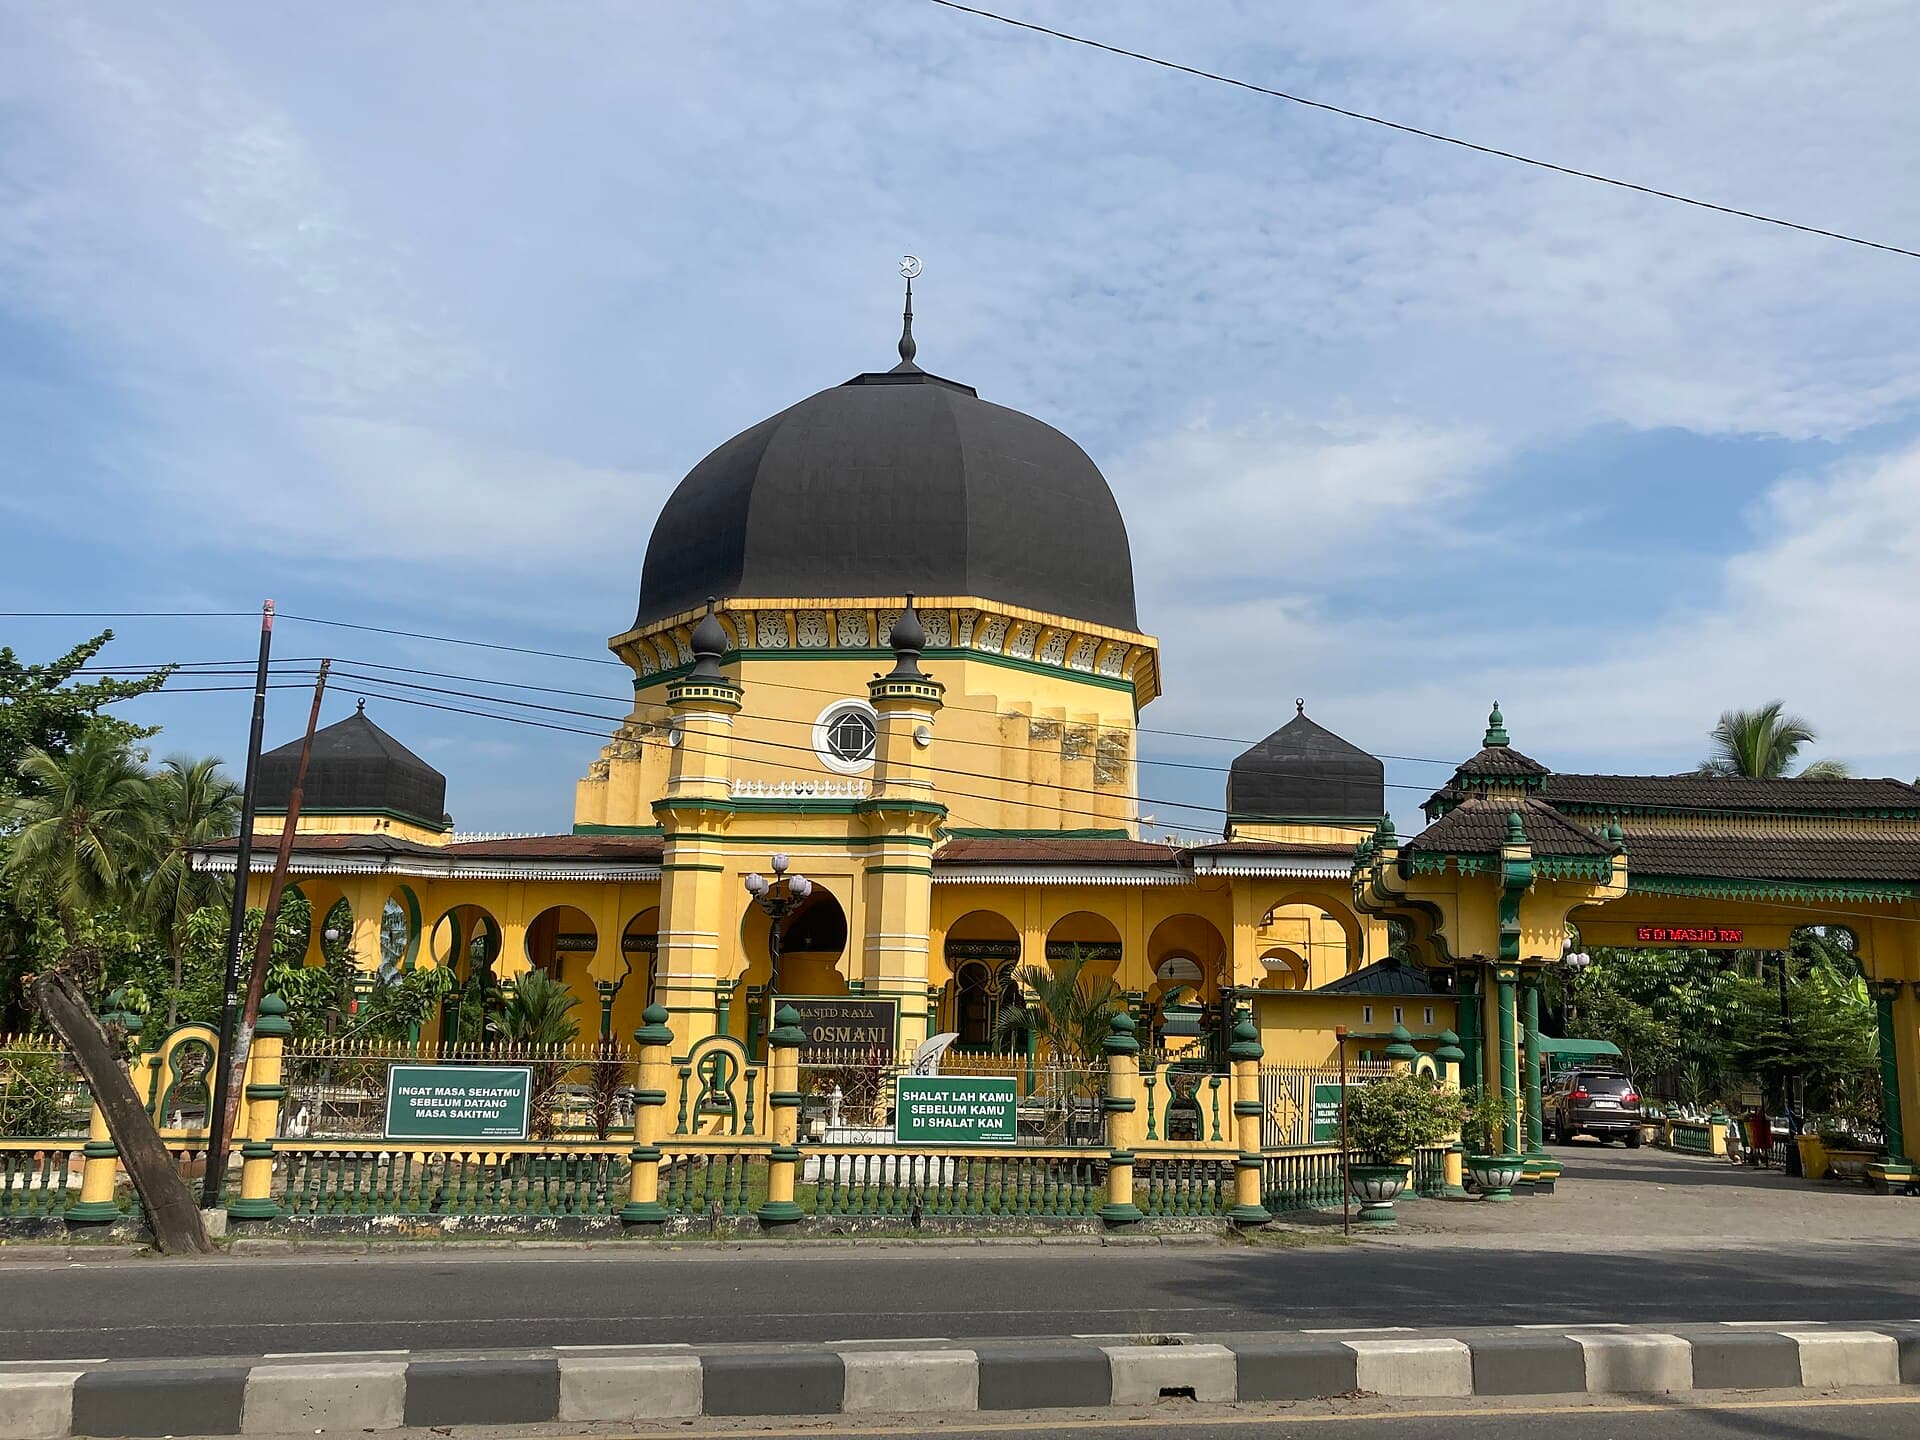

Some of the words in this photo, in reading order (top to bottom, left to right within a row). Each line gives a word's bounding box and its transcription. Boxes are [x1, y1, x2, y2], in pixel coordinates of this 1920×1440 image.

[1653, 929, 1666, 940] DI
[1668, 929, 1717, 941] MASJID
[841, 1008, 875, 1018] RAYA
[398, 1086, 432, 1096] INGAT
[434, 1087, 466, 1097] MASA
[468, 1088, 520, 1098] SEHATMU
[902, 1091, 949, 1102] SHALAT
[952, 1092, 976, 1103] LAH
[979, 1093, 1014, 1103] KAMU
[409, 1098, 461, 1108] SEBELUM
[463, 1099, 508, 1109] DATANG
[415, 1109, 447, 1119] MASA
[449, 1110, 500, 1120] SAKITMU
[911, 1104, 967, 1115] SEBELUM
[970, 1105, 1005, 1116] KAMU
[912, 1117, 925, 1128] DI
[928, 1117, 974, 1129] SHALAT
[977, 1118, 1003, 1129] KAN
